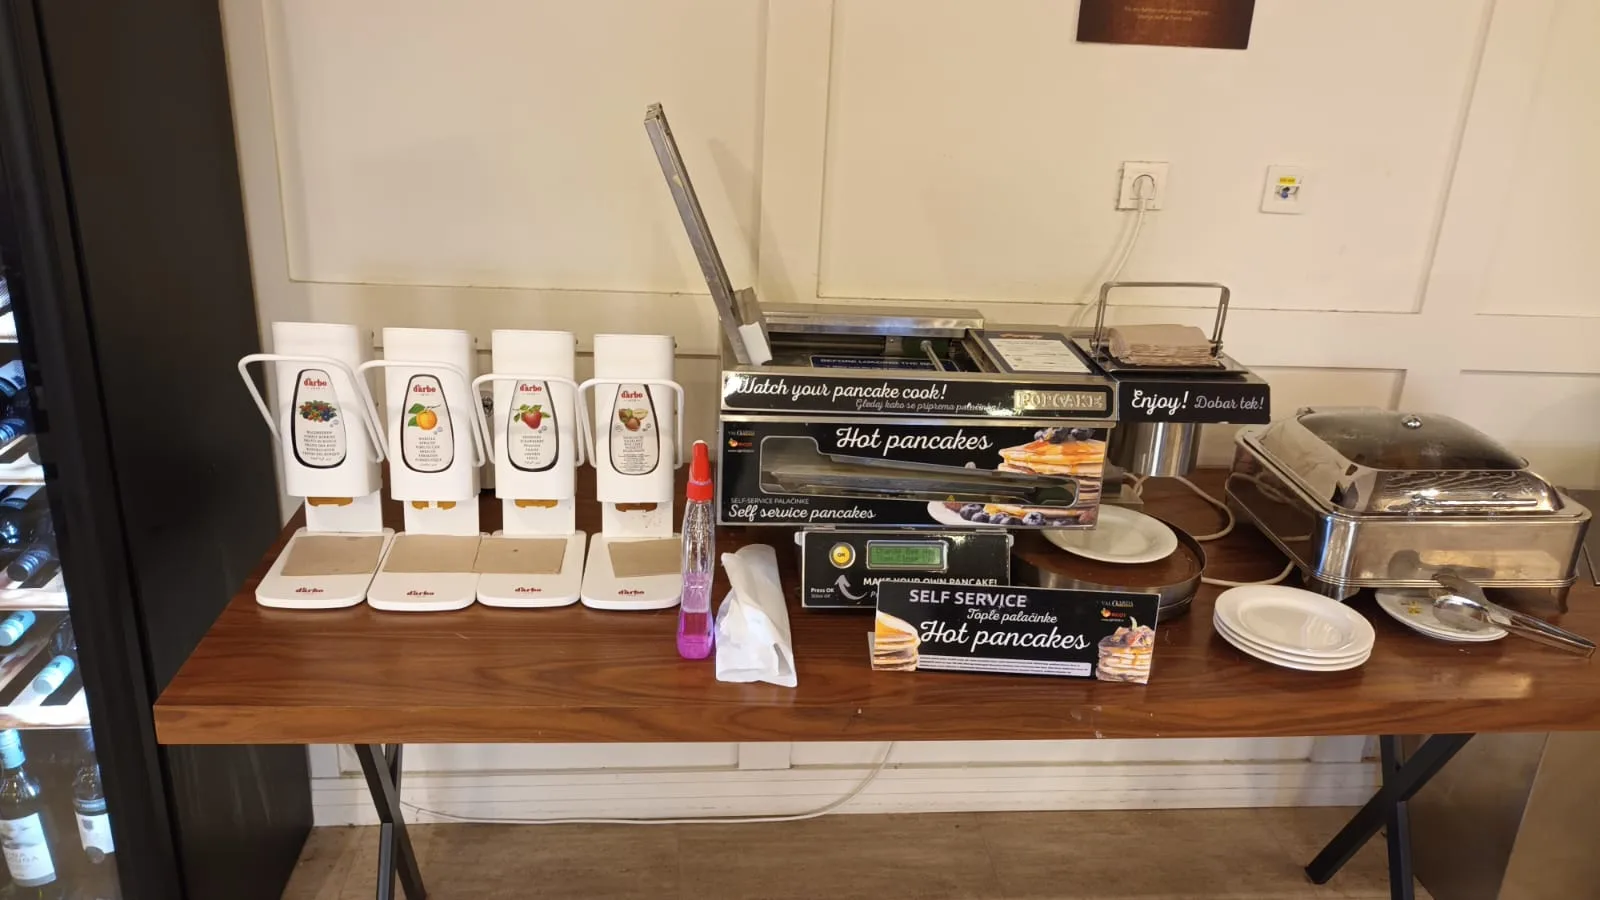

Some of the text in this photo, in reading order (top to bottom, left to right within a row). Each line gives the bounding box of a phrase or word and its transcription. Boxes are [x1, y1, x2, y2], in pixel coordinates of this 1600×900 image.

[737, 376, 948, 403] Watch your pancake cook!
[855, 398, 883, 411] Gledaj
[884, 399, 905, 409] kako
[906, 402, 915, 410] se
[917, 401, 955, 413] priprema
[1131, 388, 1265, 415] Enjoy! Dobar tek!
[836, 426, 993, 457] Hot pancakes
[728, 504, 876, 523] Self service pancakes
[909, 589, 1027, 608] SELF SERVICE
[967, 608, 1058, 624] Tople palačinke
[920, 620, 1090, 653] Hot pancakes
